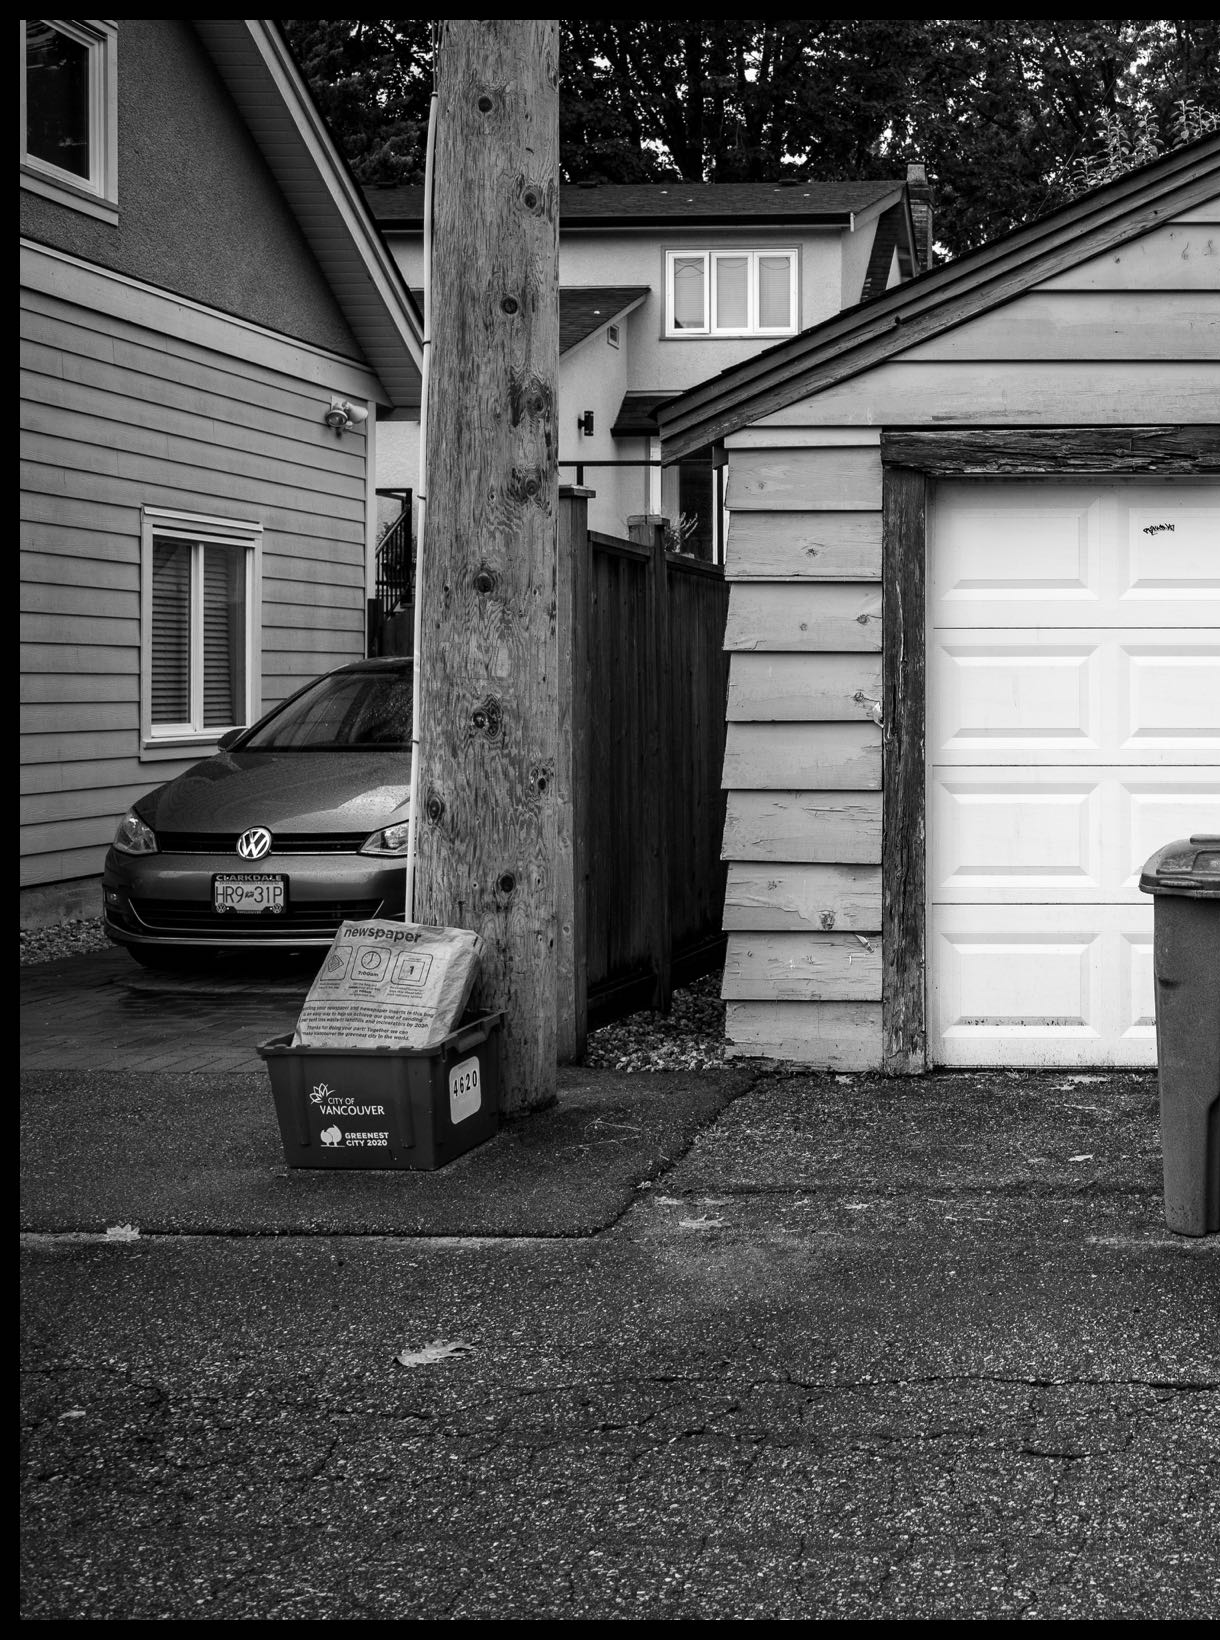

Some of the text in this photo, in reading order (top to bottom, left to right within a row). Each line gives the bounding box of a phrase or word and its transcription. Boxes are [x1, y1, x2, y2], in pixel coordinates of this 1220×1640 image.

[343, 926, 422, 943] newspaper
[409, 965, 415, 975] 1
[360, 1006, 388, 1014] newspaper
[353, 1011, 373, 1019] achieve
[453, 1069, 478, 1097] 4620
[327, 1097, 356, 1105] CITY OF
[320, 1105, 385, 1115] VANCOUVER
[346, 1139, 388, 1147] CITY 2020
